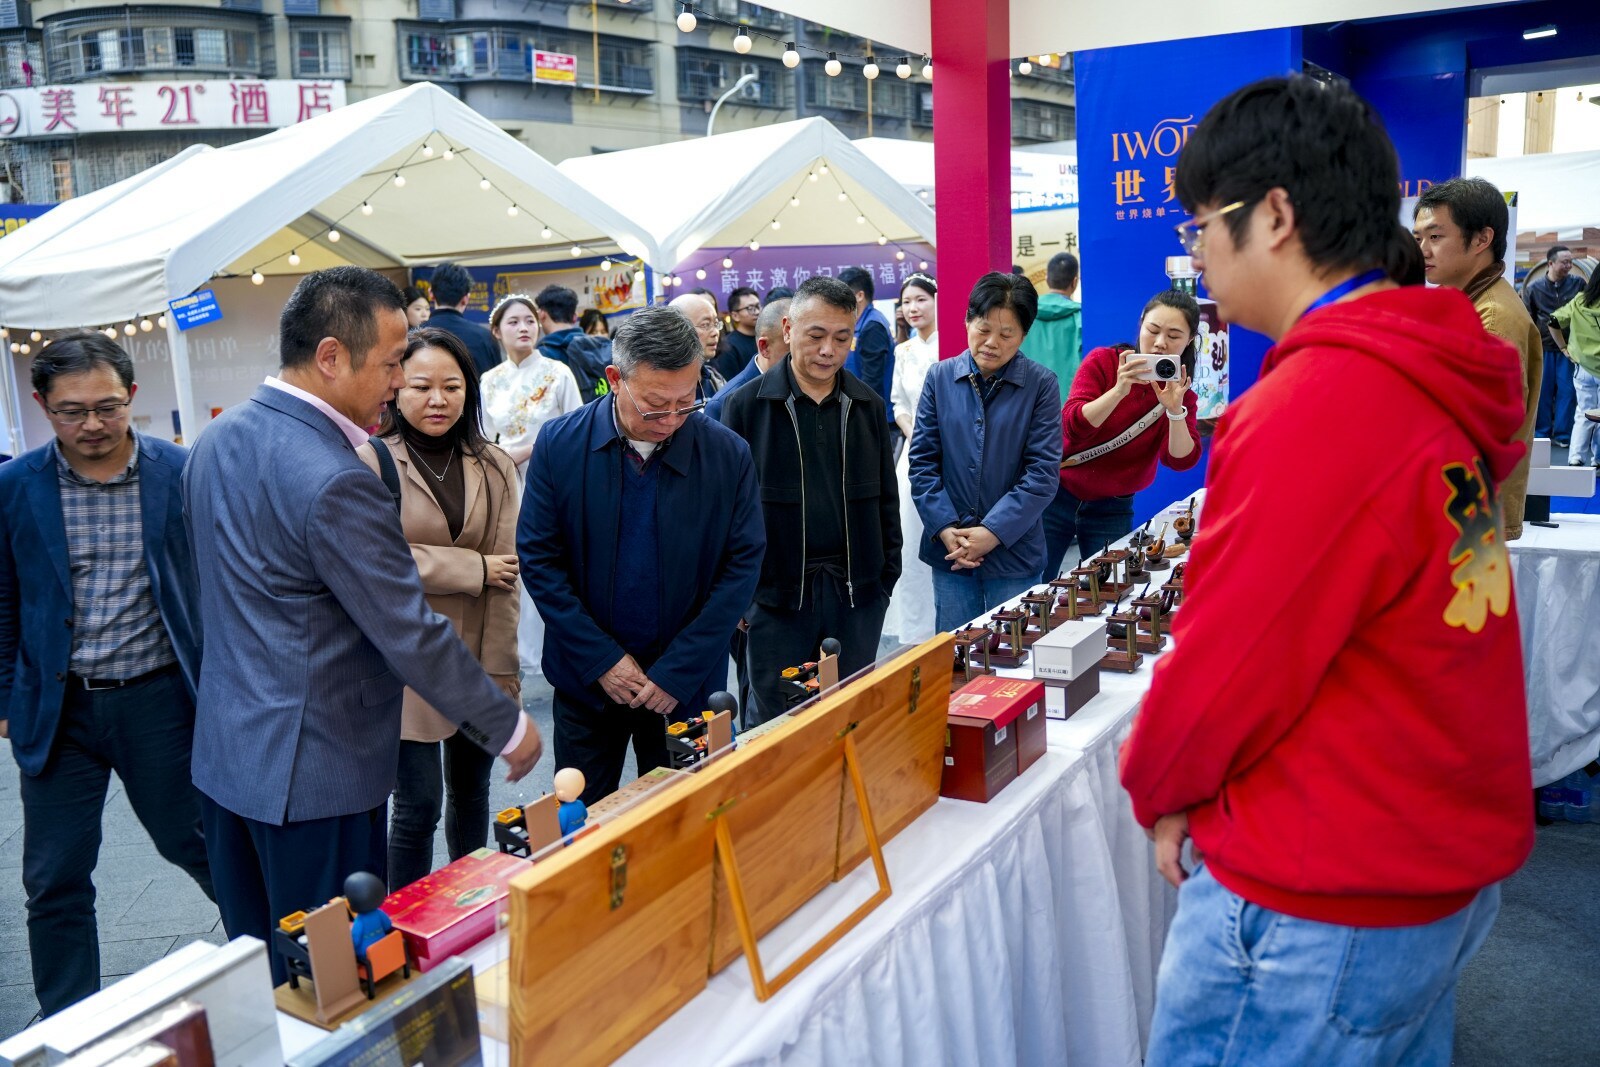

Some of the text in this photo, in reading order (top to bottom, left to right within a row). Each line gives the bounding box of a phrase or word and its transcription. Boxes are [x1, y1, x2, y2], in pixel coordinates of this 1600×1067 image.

[1115, 207, 1193, 221] 世界烧单一
